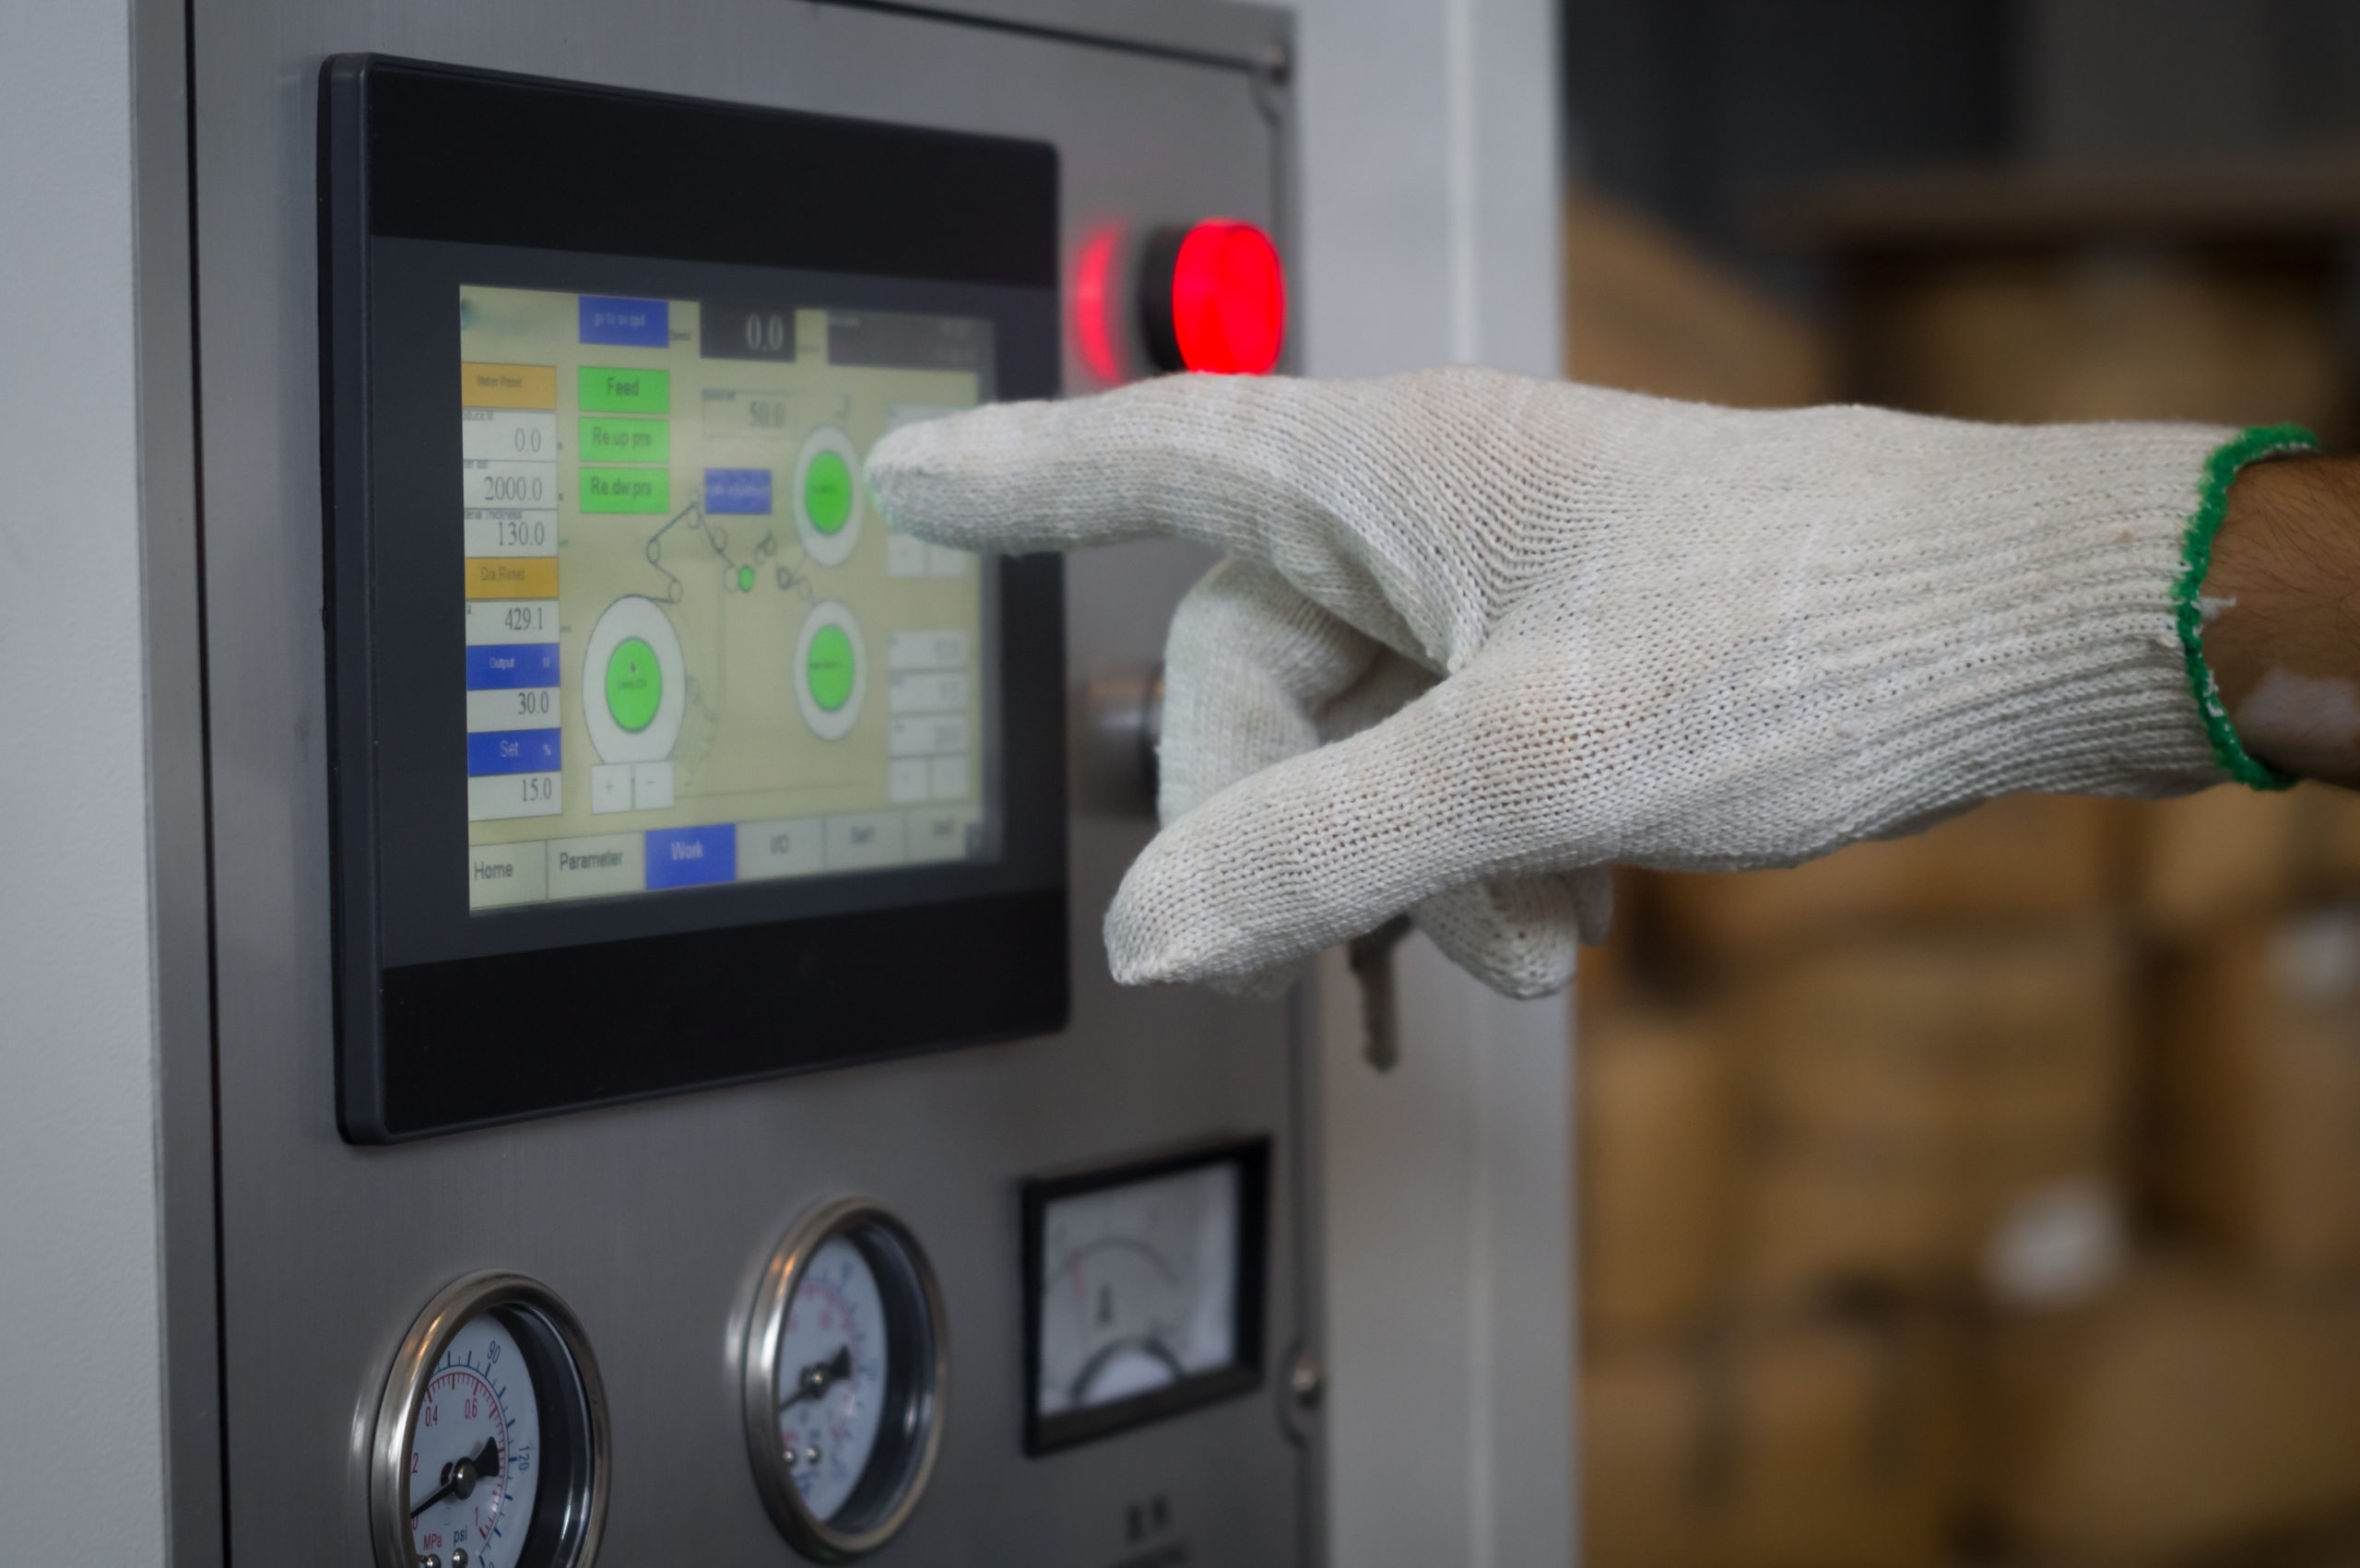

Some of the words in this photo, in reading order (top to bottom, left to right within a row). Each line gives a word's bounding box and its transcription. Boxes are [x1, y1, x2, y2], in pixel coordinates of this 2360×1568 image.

[746, 313, 784, 351] 0.0
[607, 377, 640, 397] Feed
[514, 428, 541, 453] 0.0
[484, 476, 543, 501] 2000.0
[499, 522, 545, 546] 130.0
[504, 607, 544, 631] 429.1
[518, 691, 549, 714] 30.0
[500, 740, 519, 758] Set
[521, 779, 552, 802] 15.0
[560, 850, 623, 871] Parameter
[671, 841, 704, 861] Work
[474, 861, 513, 880] Home
[487, 1339, 502, 1364] 90
[425, 1405, 439, 1428] 0.4
[465, 1397, 478, 1420] 0.6
[518, 1444, 531, 1471] 120
[423, 1533, 442, 1550] MPa
[453, 1525, 468, 1547] psi
